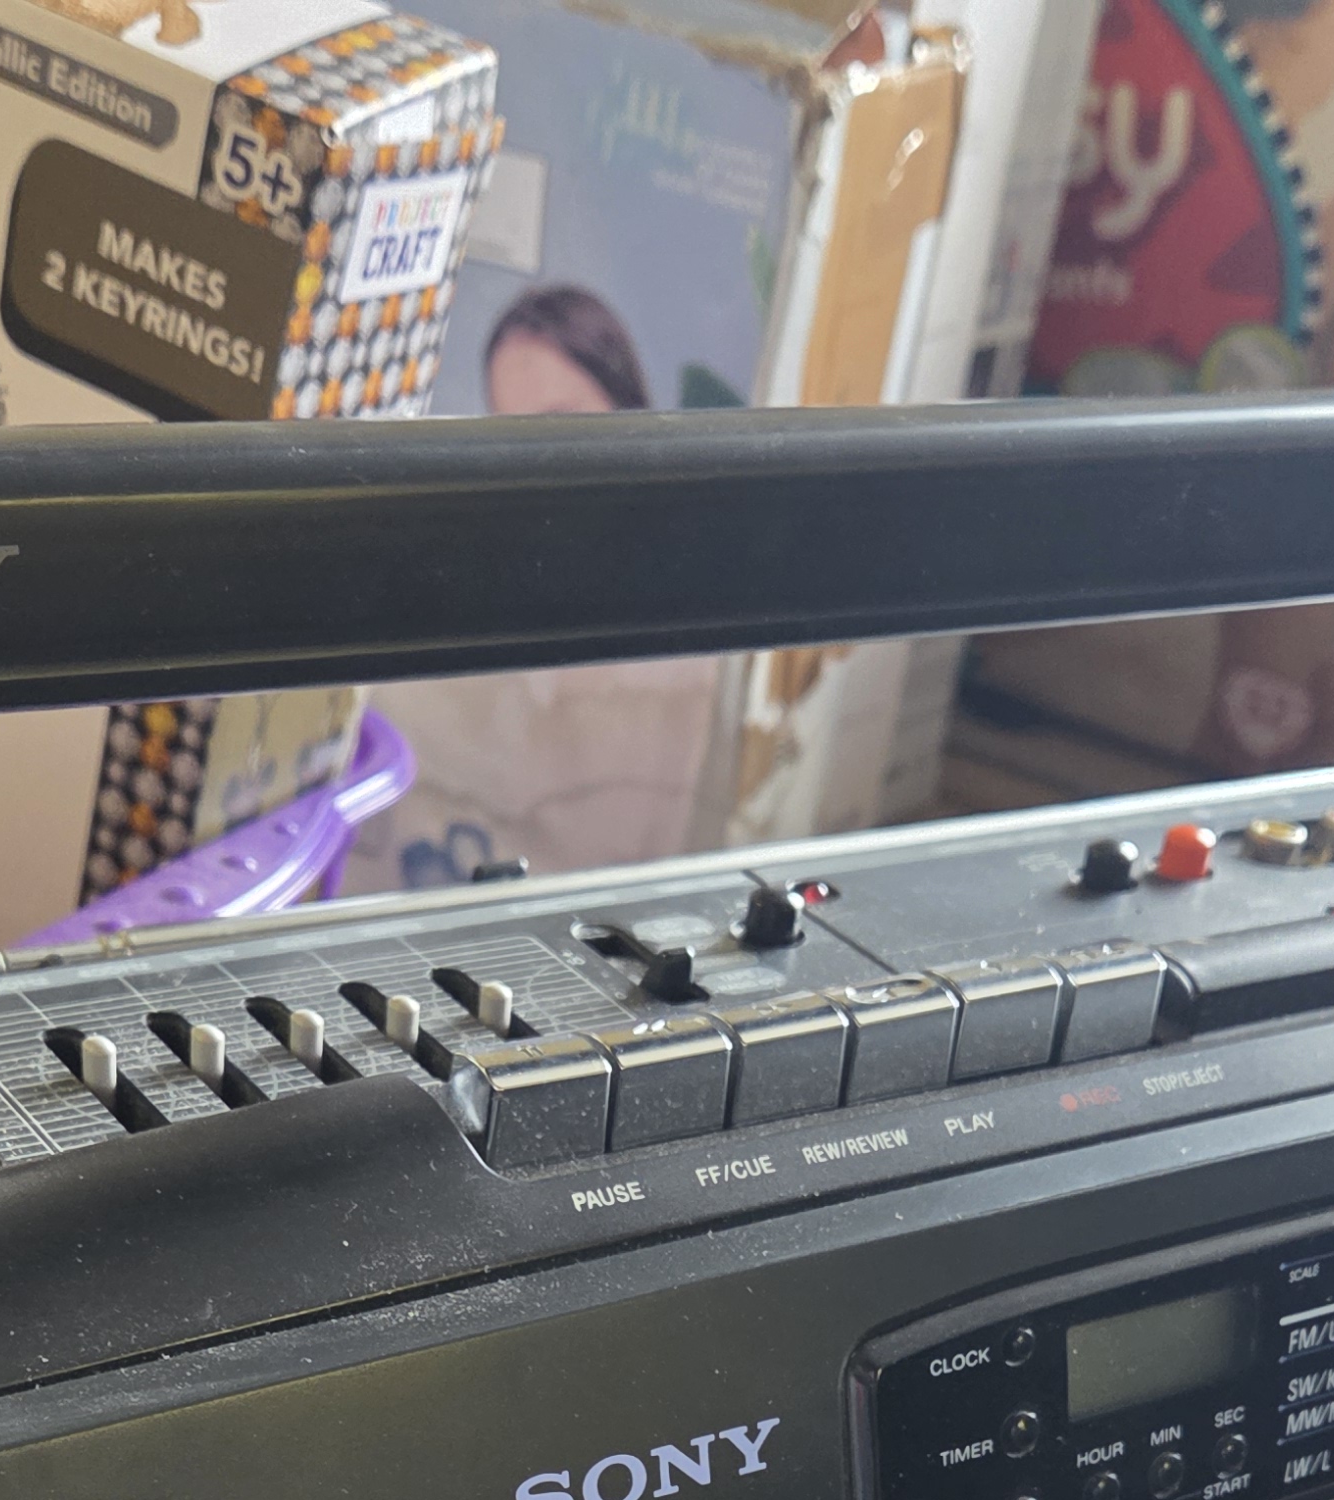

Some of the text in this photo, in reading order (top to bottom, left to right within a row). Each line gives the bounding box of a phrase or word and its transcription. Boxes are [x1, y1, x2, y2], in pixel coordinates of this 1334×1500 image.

[46, 56, 152, 133] Edition
[223, 133, 293, 202] 5+
[96, 219, 229, 311] MAKES
[362, 226, 443, 281] CRAFT
[40, 249, 265, 385] 2 KEYRINGS!
[1142, 1063, 1224, 1097] STOP/EJECT
[943, 1111, 996, 1137] PLAY
[802, 1128, 910, 1165] REW/REVIEW
[695, 1155, 776, 1187] FF/CUE
[571, 1181, 645, 1213] PAUSE
[929, 1347, 991, 1377] CLOCK
[1214, 1405, 1246, 1428] SEC
[1149, 1425, 1182, 1447] MIN
[940, 1439, 995, 1468] TIMER
[1076, 1441, 1125, 1469] HOUR
[1284, 1449, 1331, 1483] LW/L
[1203, 1473, 1252, 1500] START
